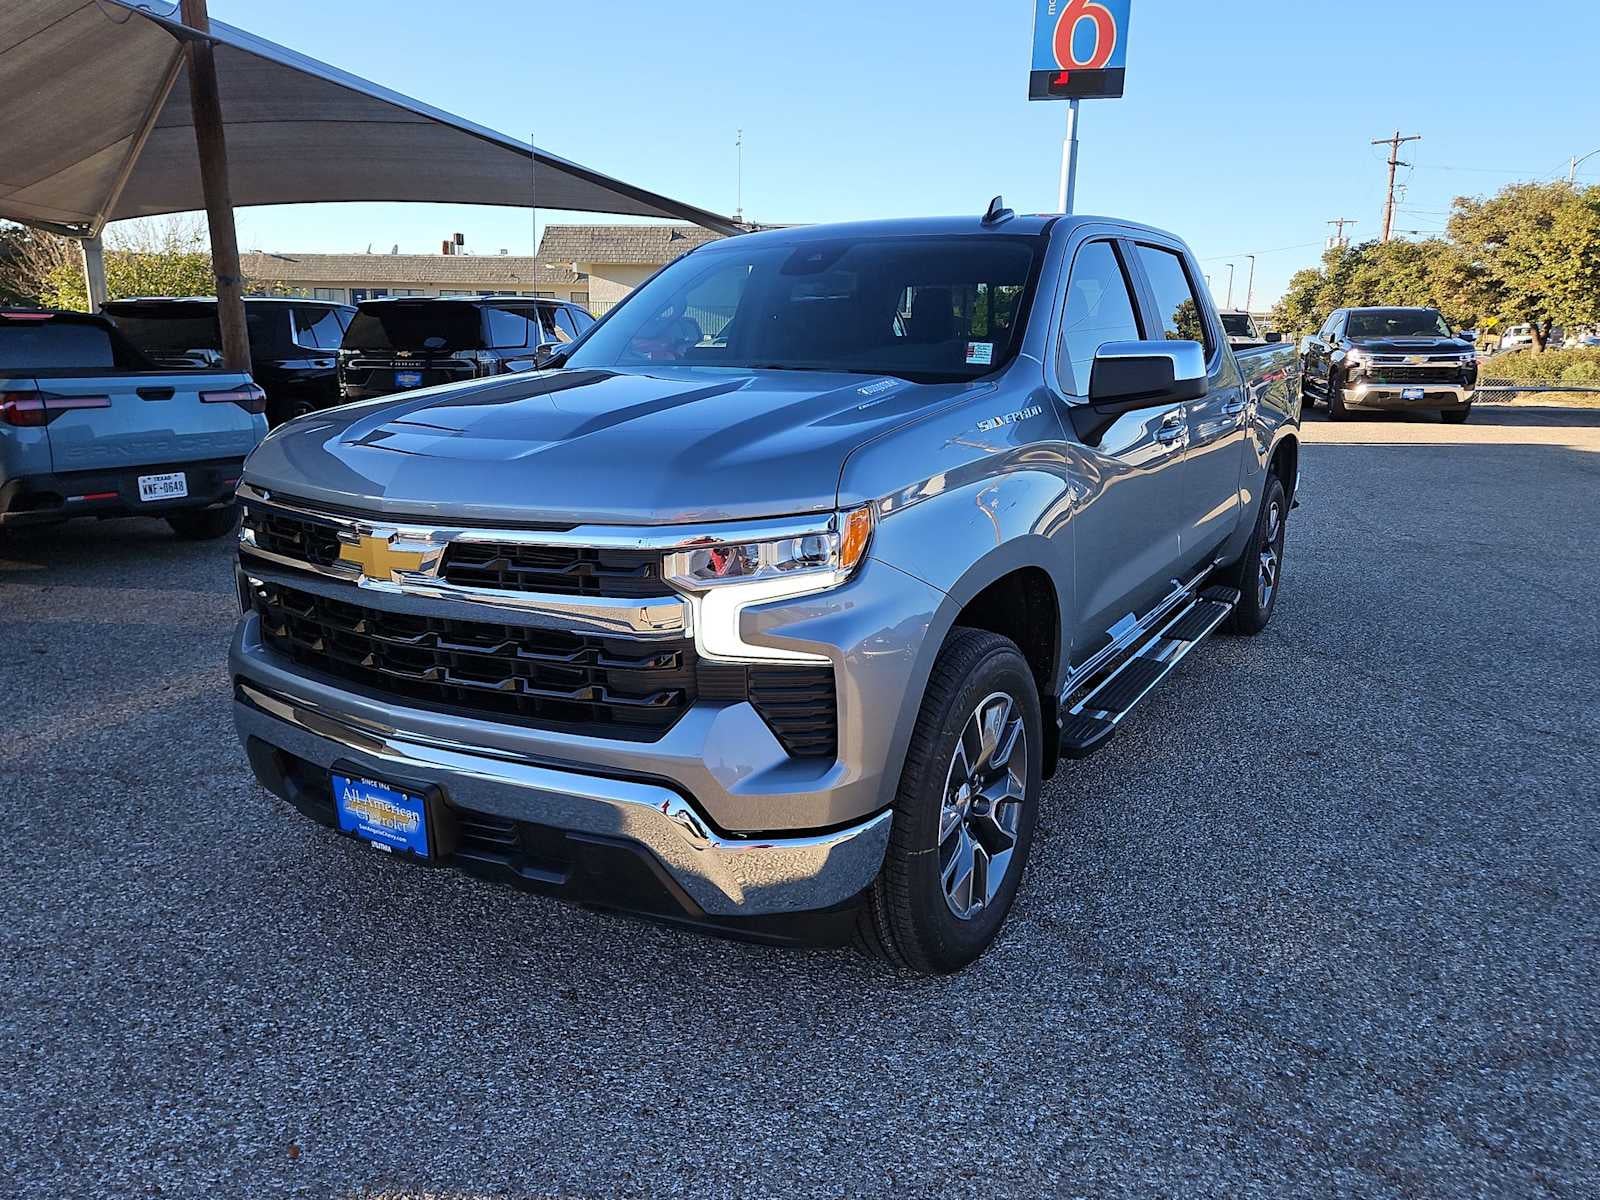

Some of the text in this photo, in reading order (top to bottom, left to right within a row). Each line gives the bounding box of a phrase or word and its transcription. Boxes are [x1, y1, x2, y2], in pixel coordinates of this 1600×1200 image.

[1052, 0, 1117, 70] 6
[976, 405, 1042, 432] SILVERADO
[361, 777, 378, 788] SINCE
[343, 787, 420, 821] All American
[356, 807, 408, 833] Chevrolet
